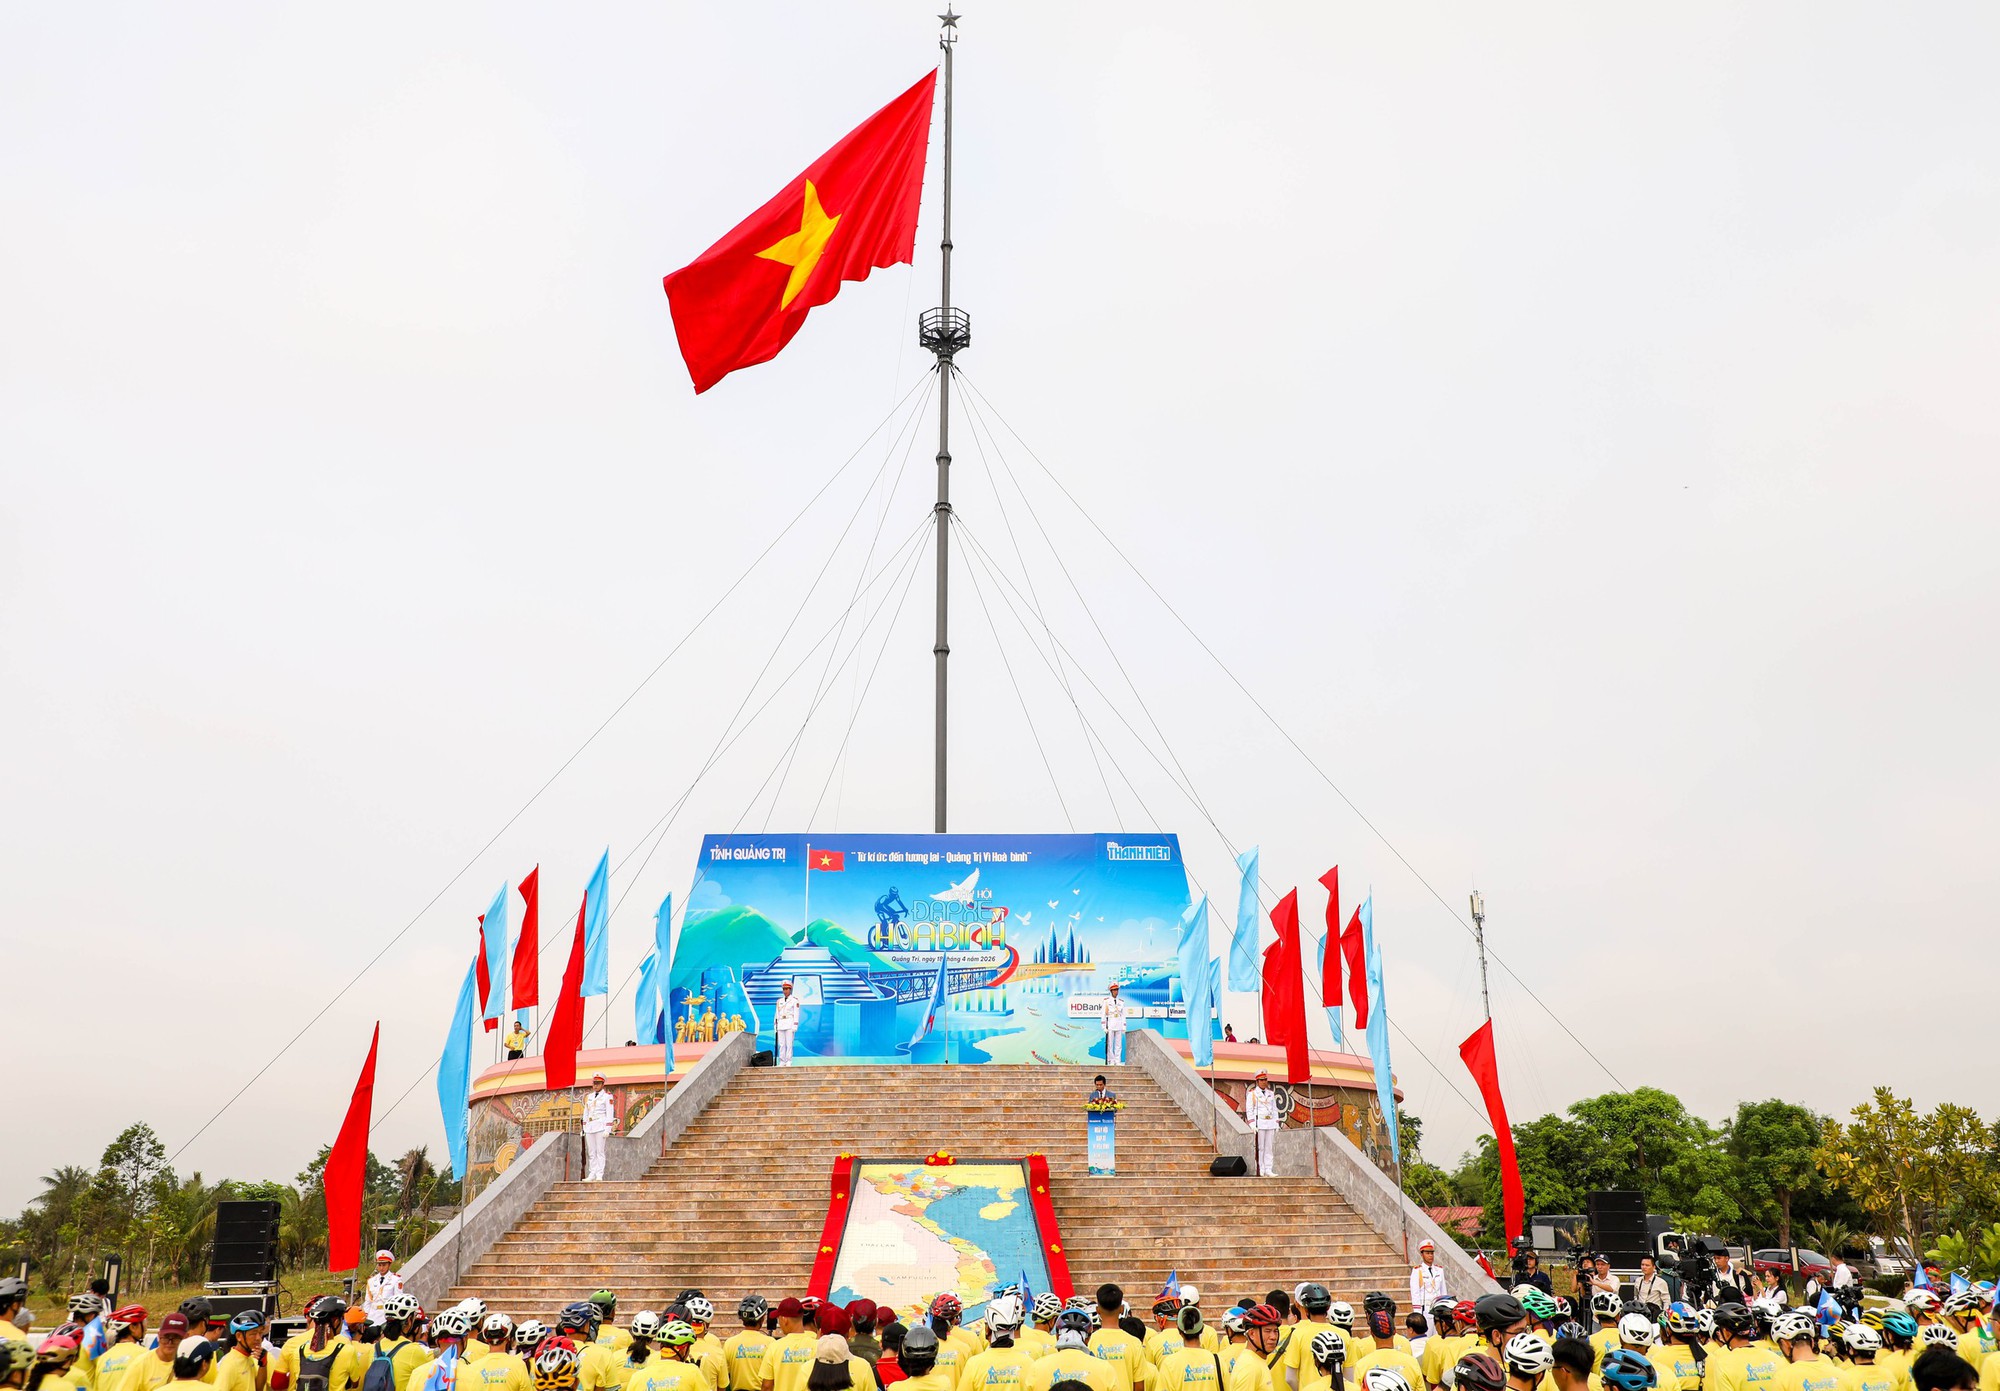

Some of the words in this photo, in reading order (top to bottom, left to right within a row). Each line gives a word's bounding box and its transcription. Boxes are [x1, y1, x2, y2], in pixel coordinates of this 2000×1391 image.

[710, 844, 732, 860] TỈNH
[733, 844, 771, 860] QUẢNG
[771, 848, 786, 863] TRỊ
[888, 851, 904, 862] đến
[929, 852, 940, 862] lai
[946, 851, 971, 865] Quảng
[973, 852, 982, 863] Trị
[1108, 846, 1144, 860] THANH
[1145, 845, 1170, 860] NIÊN
[976, 888, 993, 900] HỘI
[944, 955, 960, 963] háng
